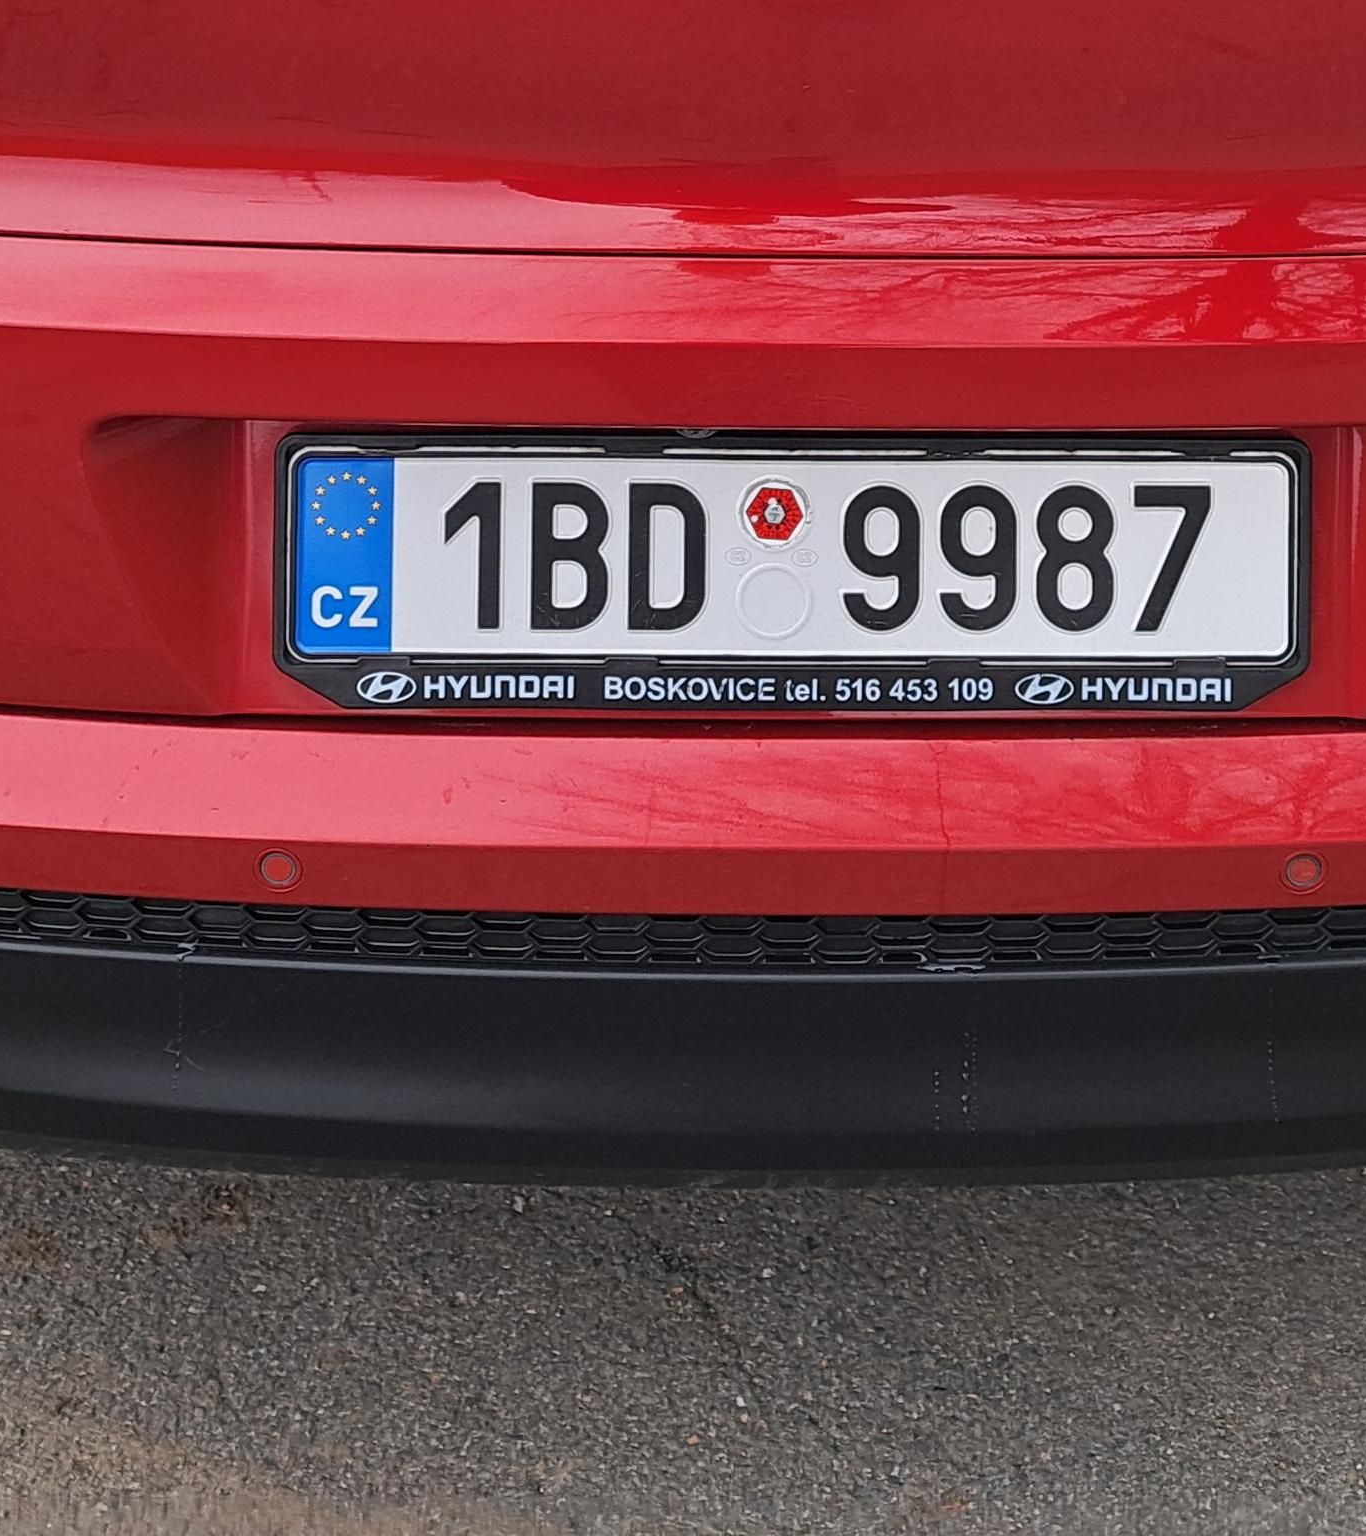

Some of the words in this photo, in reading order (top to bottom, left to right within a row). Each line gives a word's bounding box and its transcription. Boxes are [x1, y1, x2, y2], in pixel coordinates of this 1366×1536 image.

[442, 480, 708, 632] 1BD
[838, 480, 1212, 633] 9987
[310, 585, 379, 628] CZ
[423, 675, 575, 699] HYUNDAI
[604, 676, 777, 702] BOSKOVICE
[784, 677, 826, 703] tel.
[835, 677, 885, 703] 516
[888, 677, 938, 703] 453
[947, 677, 994, 703] 109
[1081, 677, 1233, 702] HYUNDAI
